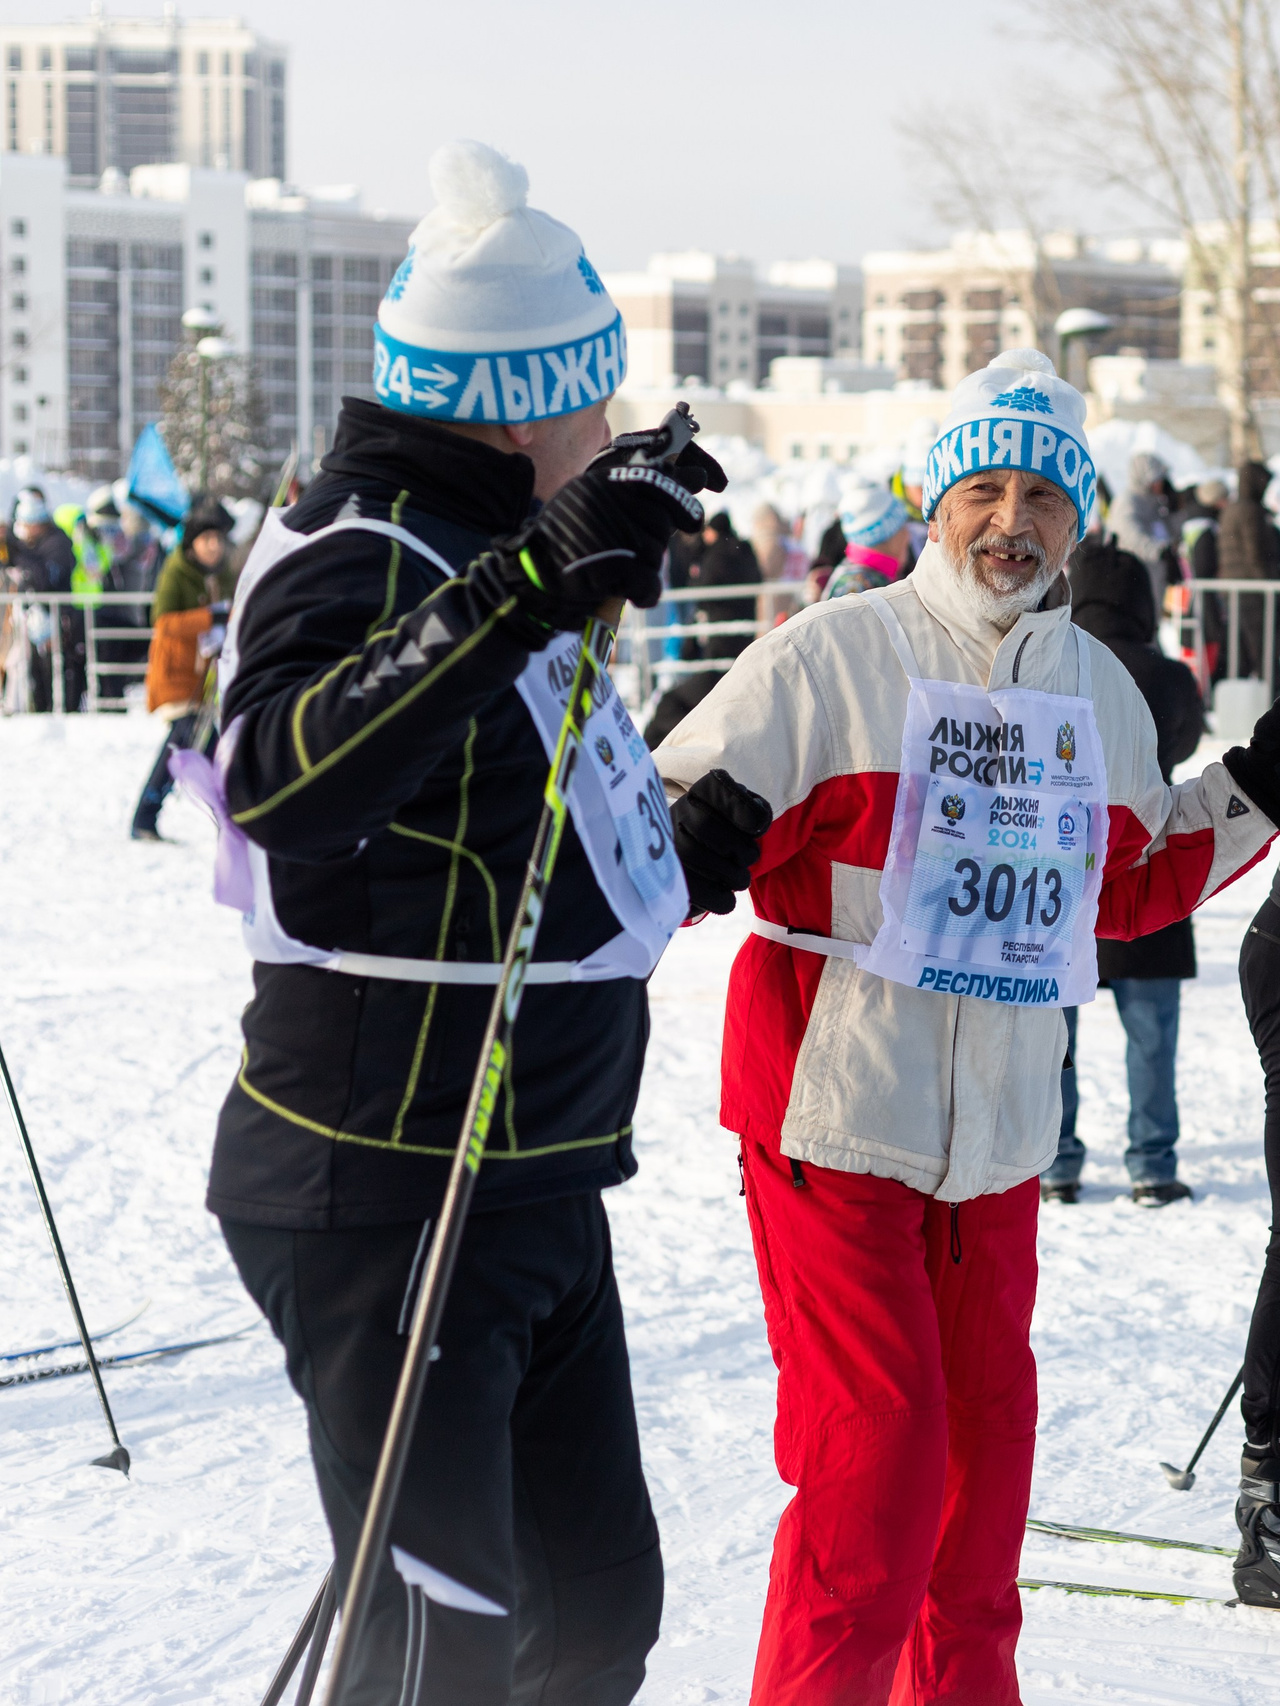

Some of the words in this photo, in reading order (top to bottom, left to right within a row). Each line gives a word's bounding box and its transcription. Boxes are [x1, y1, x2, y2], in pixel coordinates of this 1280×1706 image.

[928, 716, 1025, 753] ЛЫЖНЯ
[930, 745, 1027, 786] РОССИИ
[989, 795, 1039, 813] ЛЫЖНЯ
[989, 811, 1037, 829] РОССИИ
[986, 828, 1037, 850] 2024
[948, 857, 1062, 927] 3013
[1000, 952, 1039, 964] ТАТАРСТАН
[1002, 941, 1044, 953] РЕСПУБЛИКА
[917, 967, 1059, 1003] РЕСПУБЛИКА
